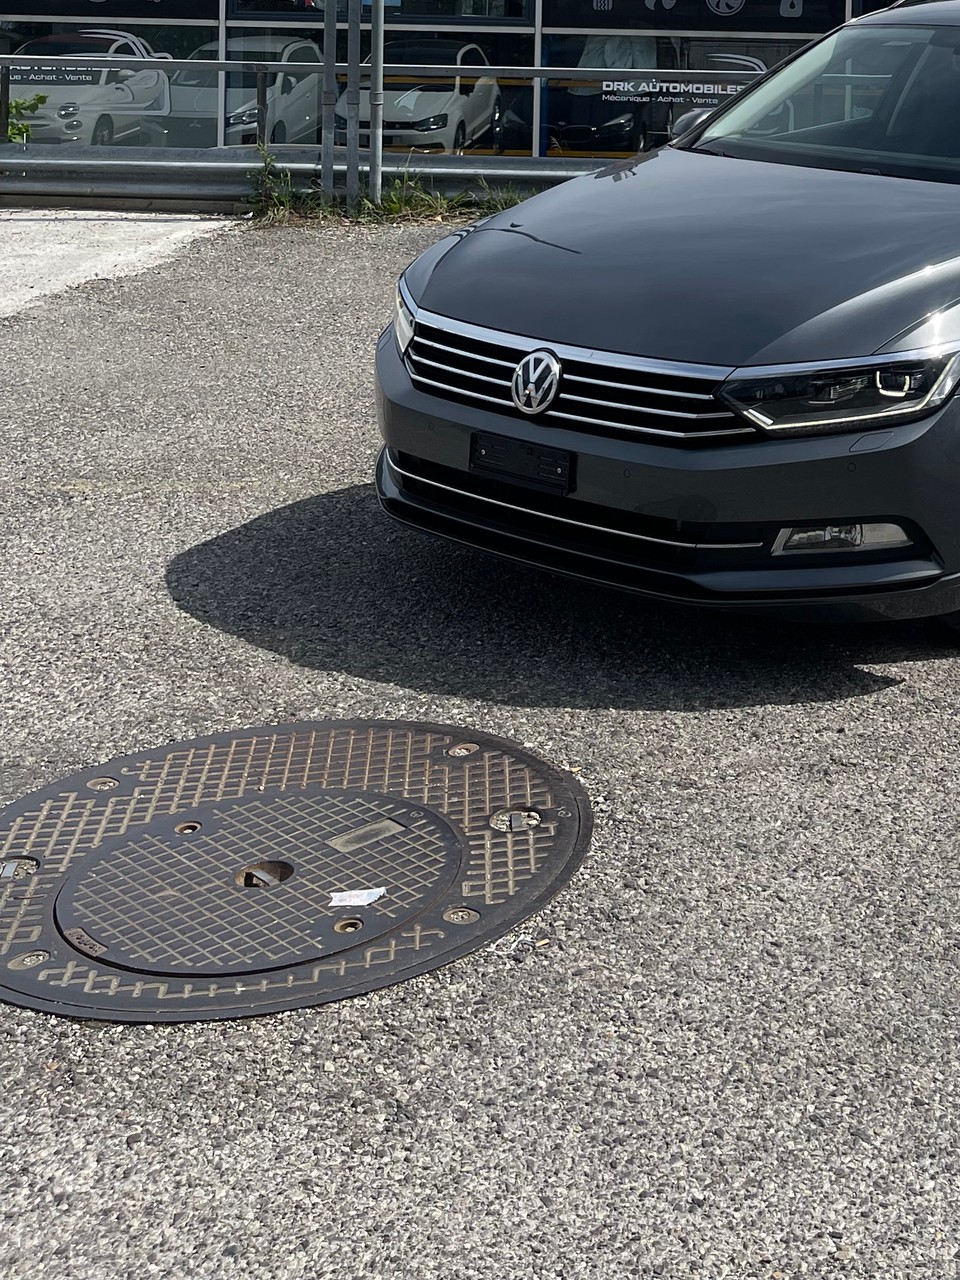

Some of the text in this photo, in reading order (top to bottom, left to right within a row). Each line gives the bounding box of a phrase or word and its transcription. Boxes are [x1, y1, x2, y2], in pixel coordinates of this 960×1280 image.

[29, 73, 57, 81] Achat
[602, 81, 635, 92] DRK
[602, 94, 650, 103] Mécanique
[656, 96, 684, 104] Achat
